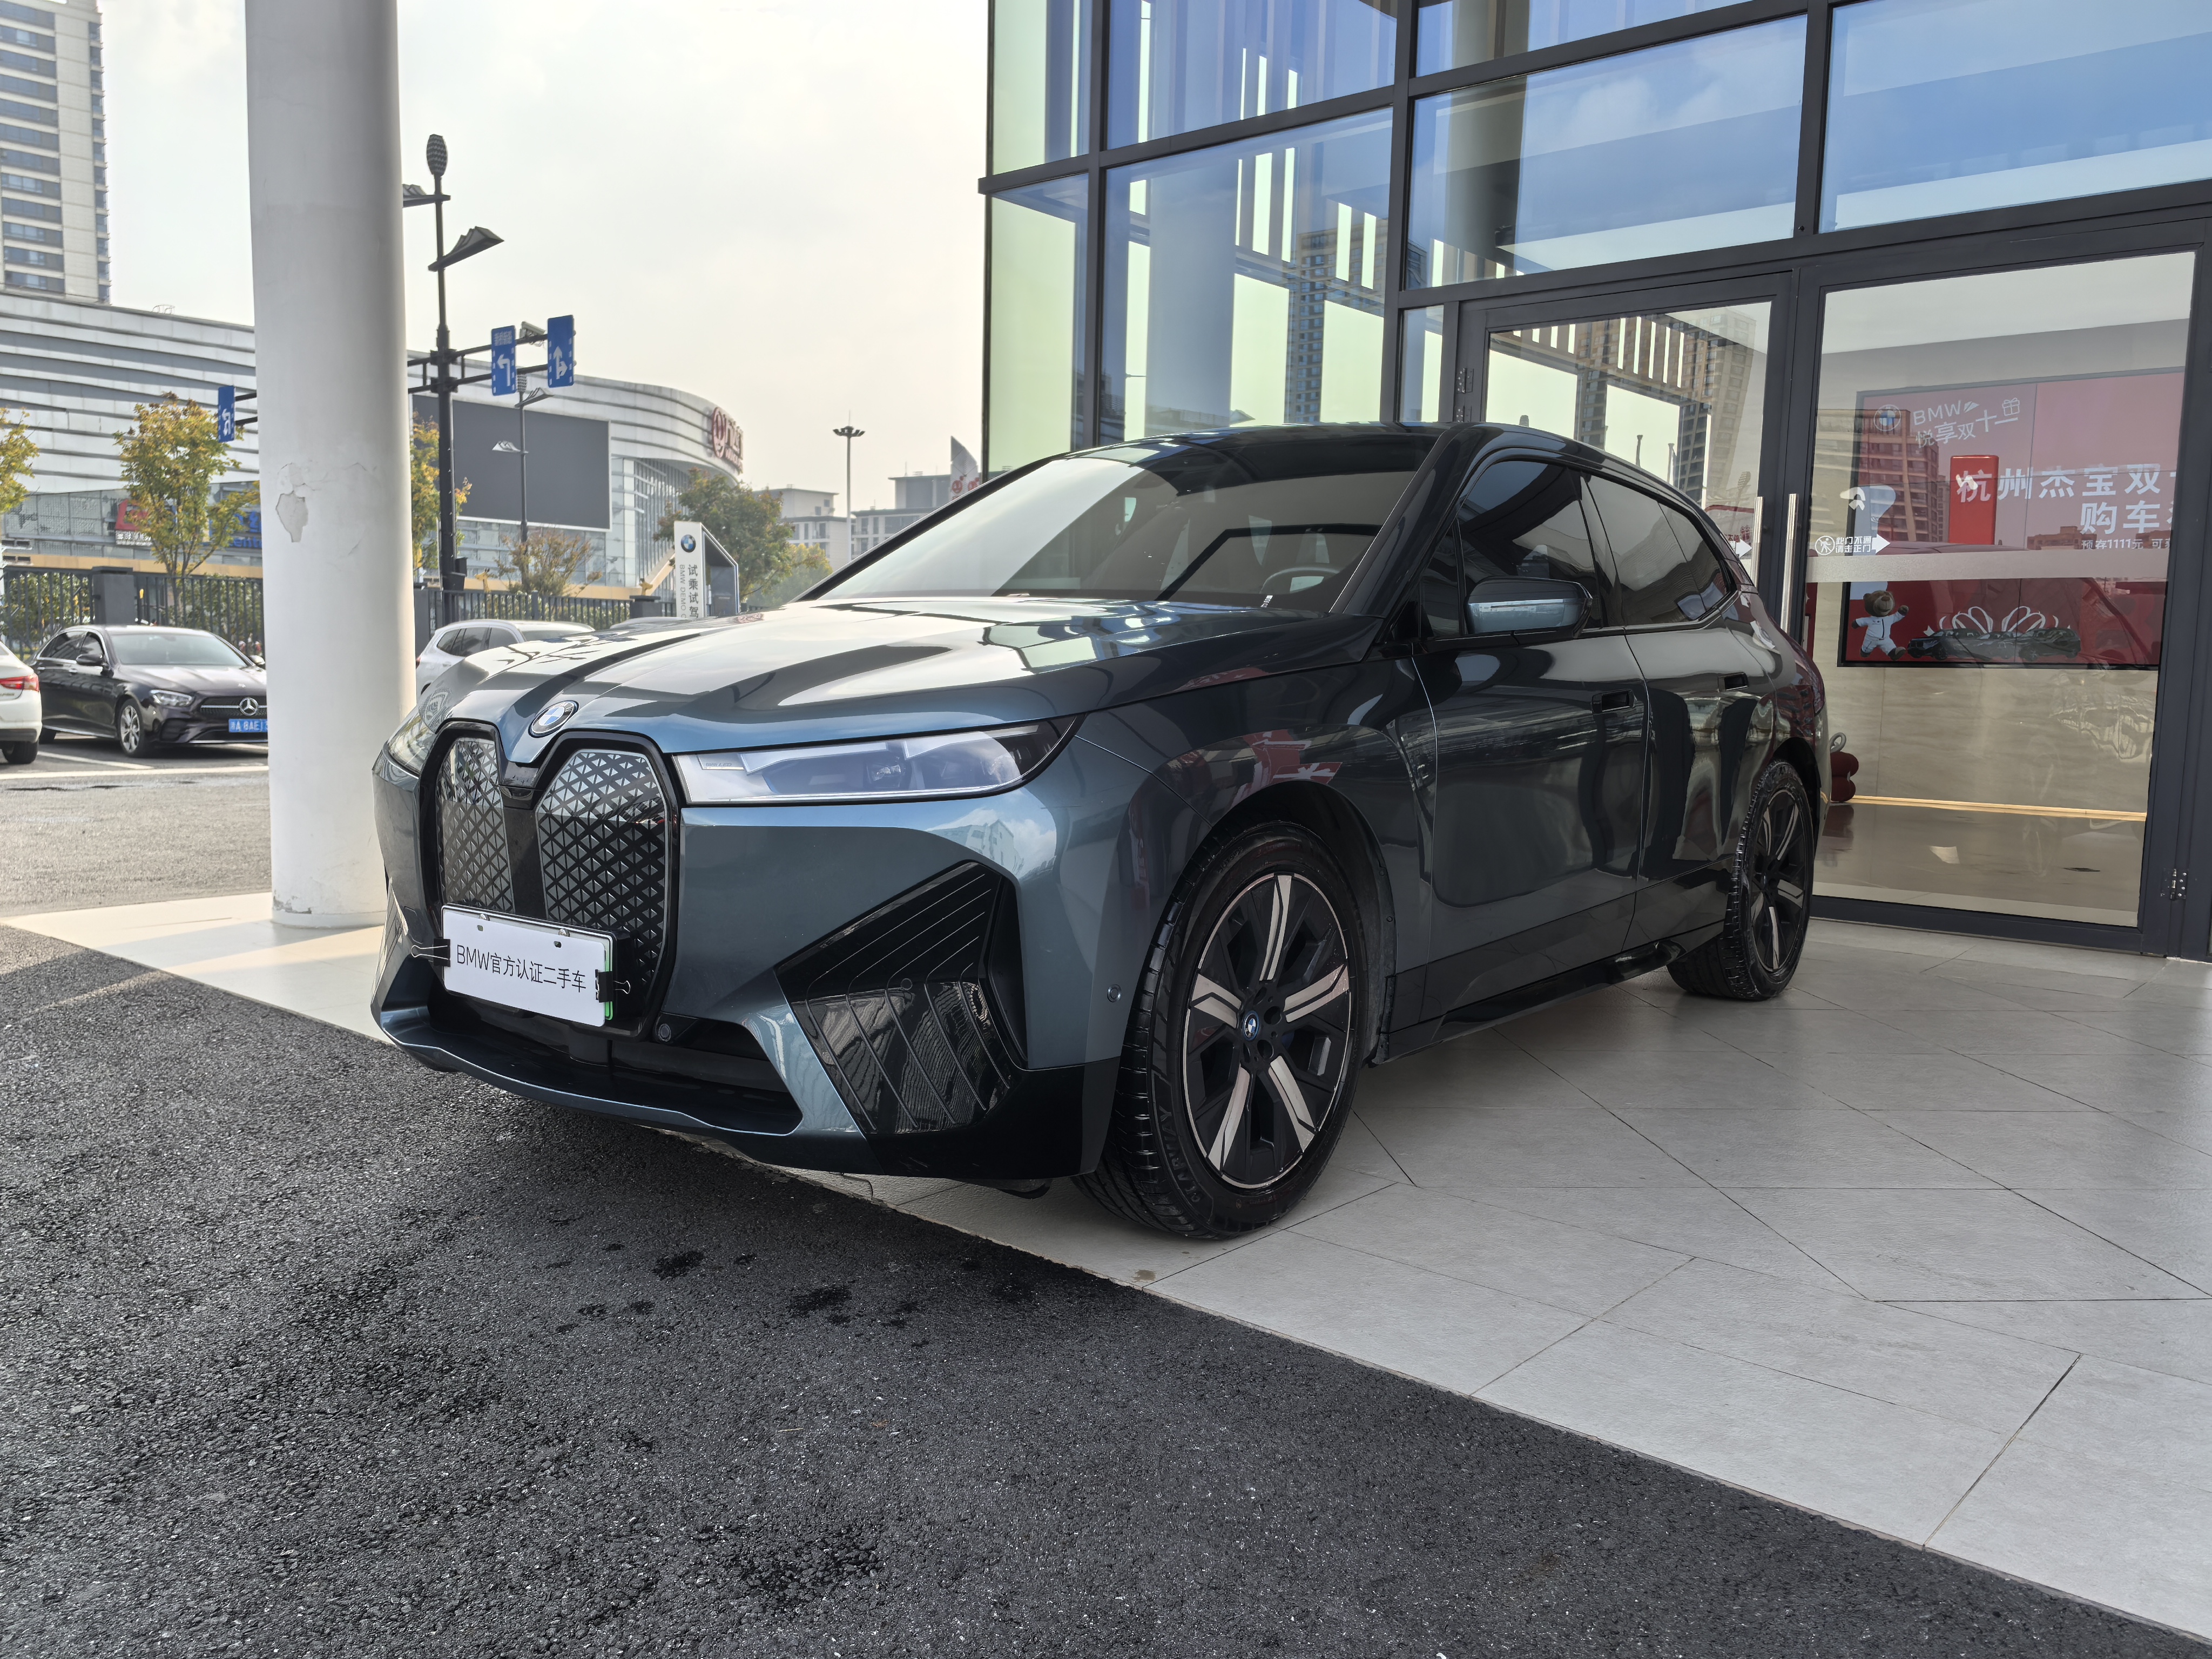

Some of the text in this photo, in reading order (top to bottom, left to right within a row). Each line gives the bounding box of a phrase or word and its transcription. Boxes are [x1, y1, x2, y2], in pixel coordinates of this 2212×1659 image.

[1913, 400, 1961, 426] BMW
[1916, 409, 2019, 448] 悦享双十一
[1955, 463, 2176, 503] 杭州杰宝双
[2080, 500, 2174, 535] 购车
[1836, 536, 1872, 545] 此门不通
[1836, 544, 1871, 554] 请走正门
[687, 564, 699, 619] 试乘试驾
[457, 944, 586, 993] BMW官方认证二手车
